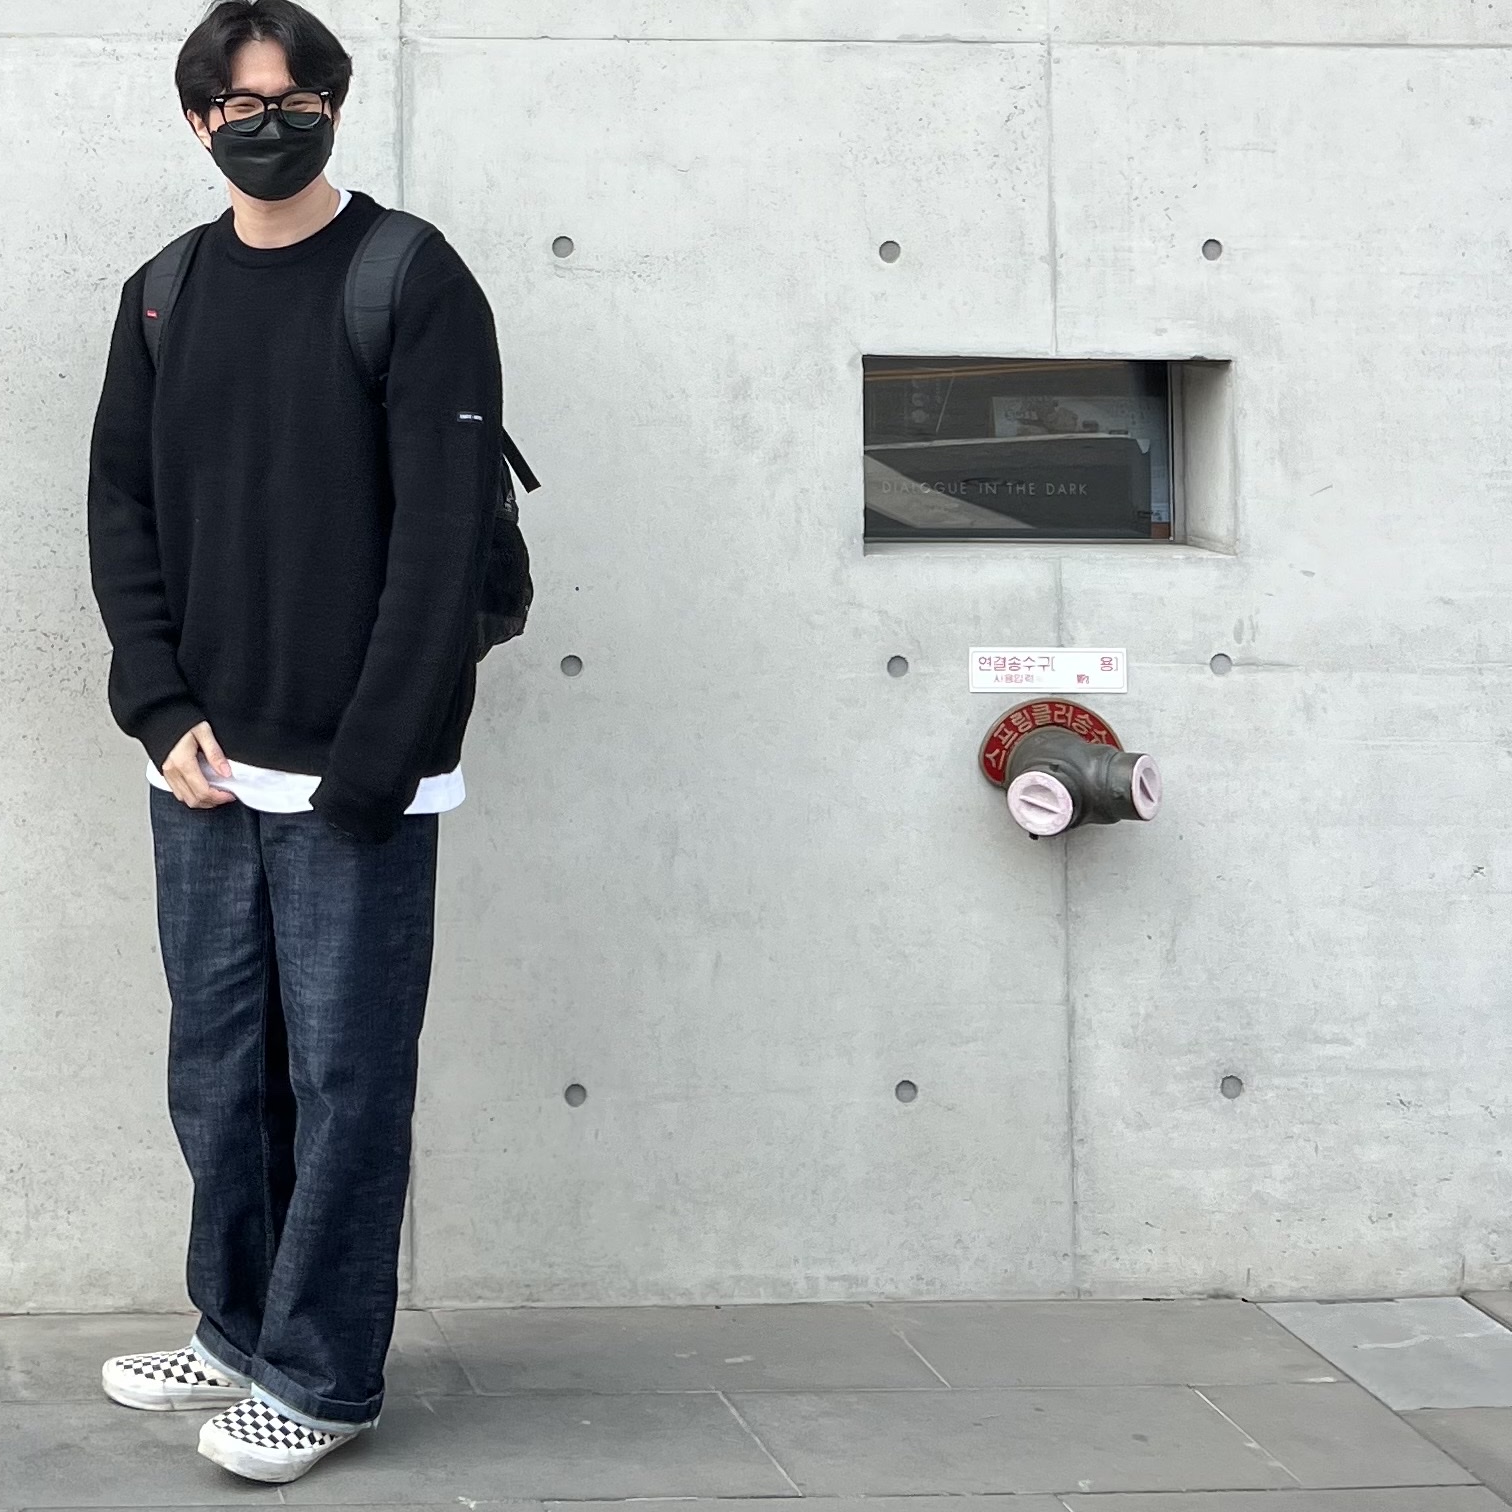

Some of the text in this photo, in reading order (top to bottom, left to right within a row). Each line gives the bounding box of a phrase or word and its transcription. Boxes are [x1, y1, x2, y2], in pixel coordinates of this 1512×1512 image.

[881, 480, 1088, 496] DIALOGUE IN THE DARK
